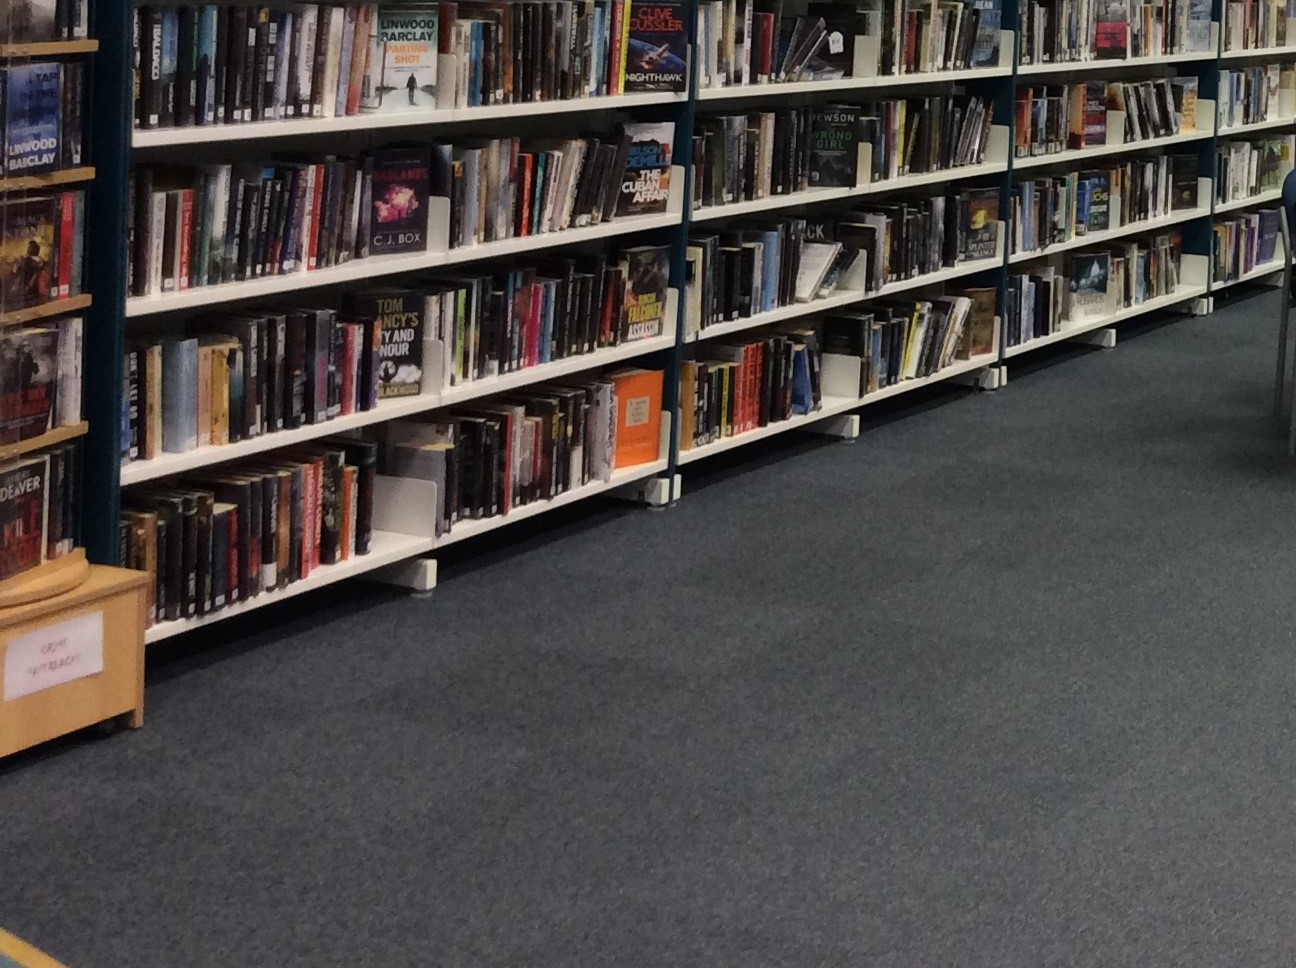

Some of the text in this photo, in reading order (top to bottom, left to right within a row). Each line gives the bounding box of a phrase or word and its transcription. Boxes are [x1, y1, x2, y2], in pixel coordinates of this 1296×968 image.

[639, 7, 672, 20] CLIVE
[381, 19, 435, 30] LINWOOD
[629, 19, 683, 32] CUSSLER
[381, 31, 433, 42] BARCLAY
[394, 55, 420, 65] SHOT
[625, 73, 682, 82] NIGHTHAWK
[9, 137, 57, 156] LINWOOD
[9, 152, 55, 171] BARCLAY
[639, 169, 661, 181] THE
[622, 181, 660, 193] CUBAN
[633, 190, 668, 204] AFFAIR
[398, 233, 421, 244] BOX
[377, 297, 403, 313] TOM
[394, 328, 415, 343] AND
[380, 343, 409, 356] NOUR
[0, 475, 41, 503] DEAVER
